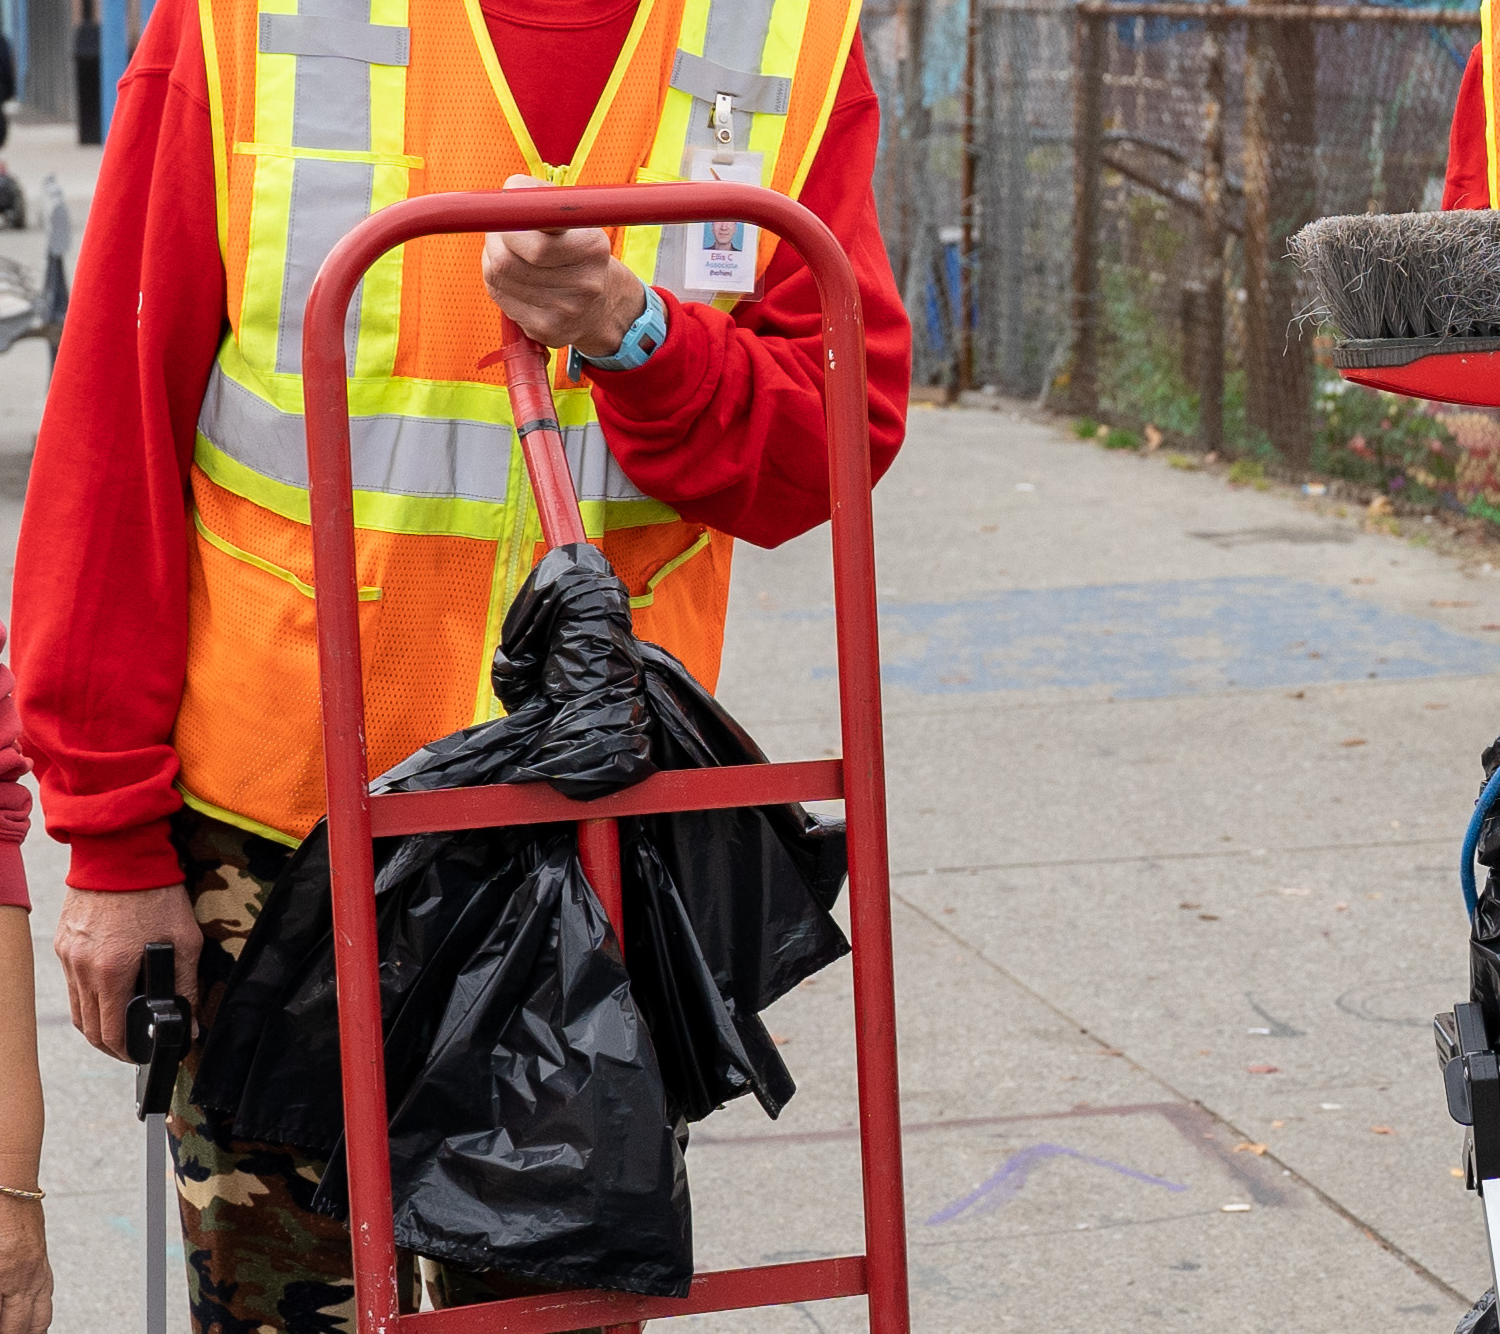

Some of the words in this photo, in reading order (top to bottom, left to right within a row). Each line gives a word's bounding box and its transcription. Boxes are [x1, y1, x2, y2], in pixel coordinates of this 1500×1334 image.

[711, 253, 725, 261] Ellis
[727, 253, 733, 261] C
[705, 261, 738, 269] Associate
